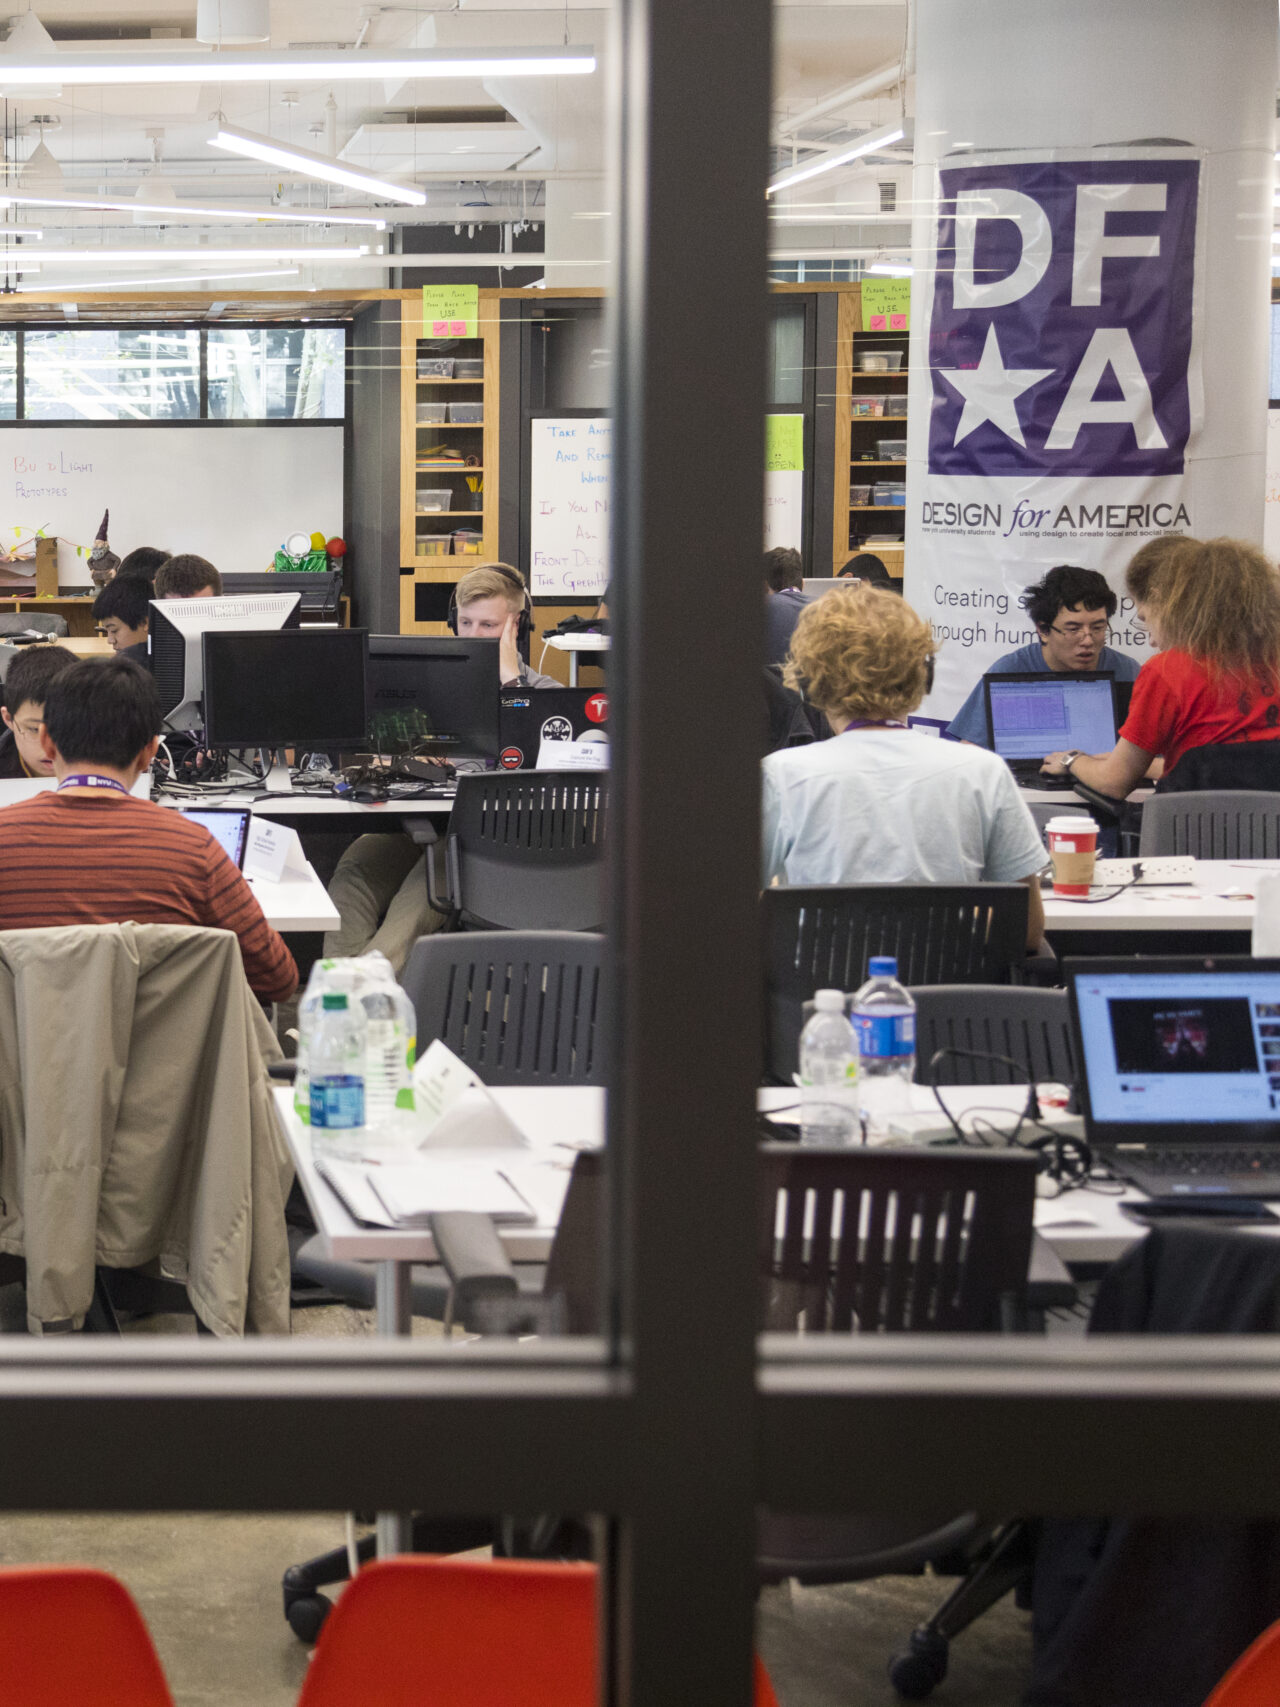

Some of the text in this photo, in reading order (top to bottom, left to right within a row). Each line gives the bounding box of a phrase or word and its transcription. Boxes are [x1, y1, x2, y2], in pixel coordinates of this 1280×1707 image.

[440, 310, 456, 318] USE
[877, 304, 898, 313] USE
[922, 499, 1191, 537] DESIGN for AMERICA
[939, 528, 966, 536] university
[1019, 530, 1040, 538] using
[1042, 530, 1067, 538] design
[934, 584, 1009, 614] Creating
[931, 621, 986, 647] hrough
